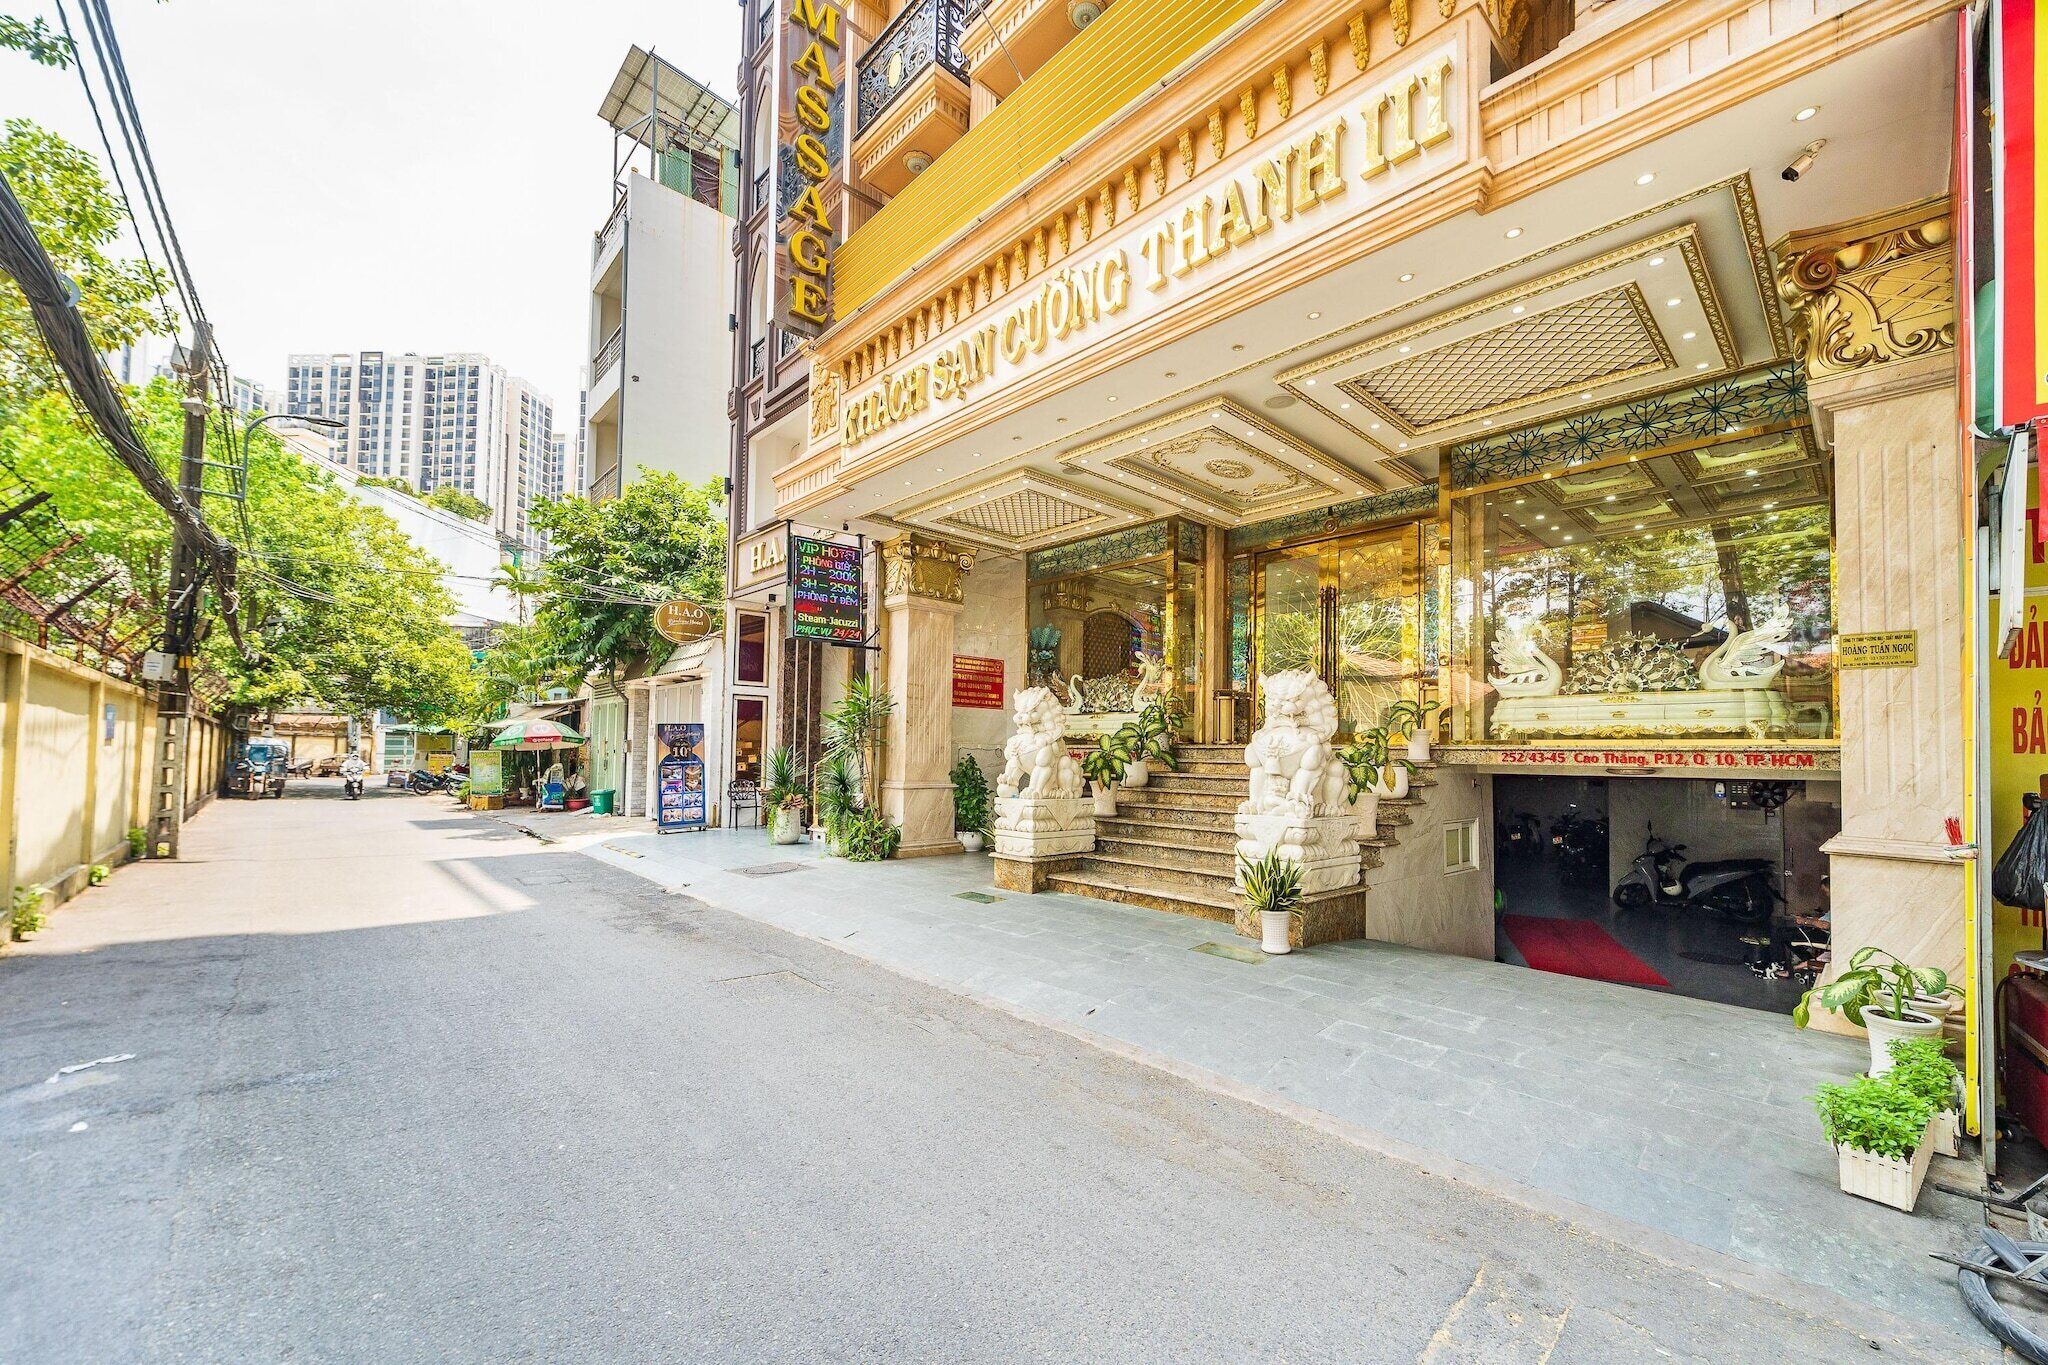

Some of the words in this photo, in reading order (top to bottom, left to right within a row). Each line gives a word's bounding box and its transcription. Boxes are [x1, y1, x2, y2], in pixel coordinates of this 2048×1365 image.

[788, 0, 839, 325] MASSAGE
[841, 362, 929, 448] KHÁCH
[933, 323, 998, 402] SẠN
[1000, 249, 1132, 366] CƯỜNG
[1138, 115, 1347, 293] THANH
[1360, 54, 1453, 180] III
[798, 540, 819, 554] VIP
[750, 536, 788, 574] H.A.
[803, 555, 833, 569] PHÒNG
[800, 564, 816, 576] 2H
[829, 569, 857, 582] 200K
[801, 577, 817, 588] 3H
[830, 581, 858, 594] 250K
[797, 589, 828, 603] PHÒNG
[668, 604, 704, 619] H.A.O
[832, 627, 860, 640] 24/24
[1842, 643, 1868, 655] HOÀNG
[1870, 640, 1890, 654] TUẤN
[1892, 642, 1914, 655] NGỌC
[2013, 689, 2048, 754] BẢ
[1573, 752, 1600, 763] Cao
[1770, 754, 1813, 767] HCM
